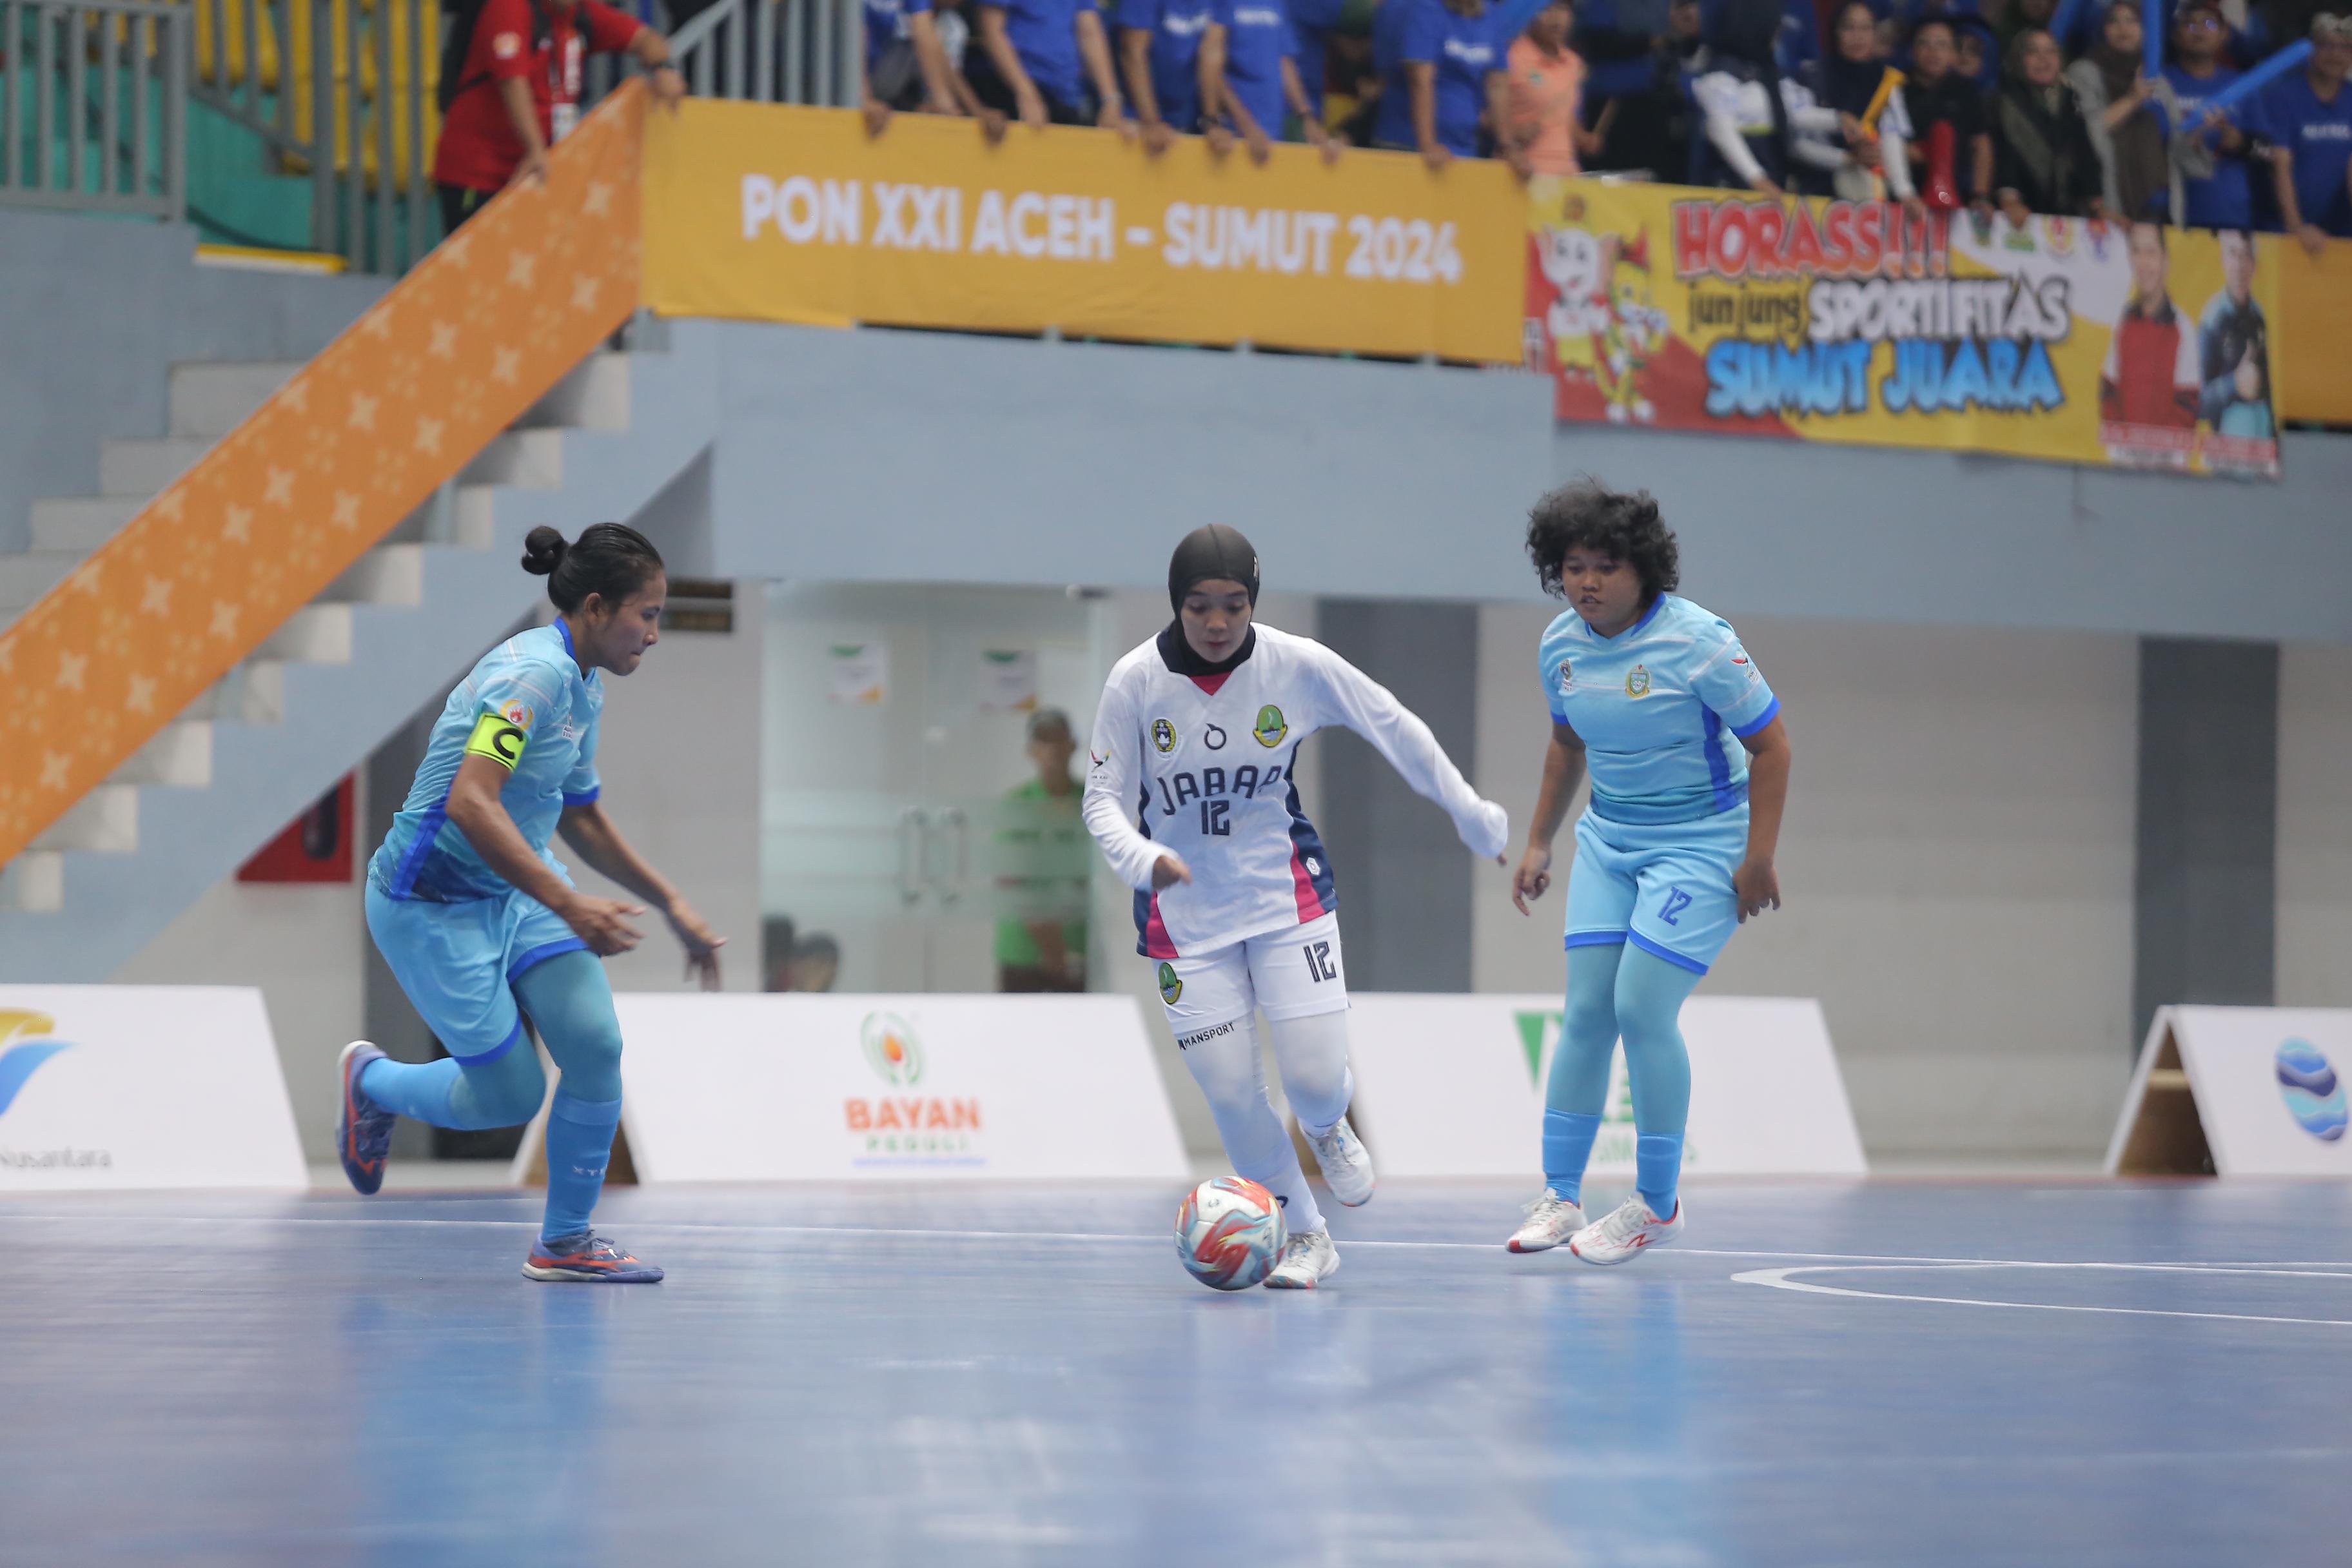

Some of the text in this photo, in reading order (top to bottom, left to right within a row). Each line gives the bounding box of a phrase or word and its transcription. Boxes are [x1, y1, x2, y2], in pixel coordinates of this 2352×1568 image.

[741, 173, 863, 245] PON
[871, 181, 962, 252] XXI
[970, 190, 1115, 261] ACEH
[1162, 201, 1340, 275] SUMUT
[1345, 213, 1463, 284] 2024
[1672, 199, 1951, 280] HORASS!!!
[1704, 337, 2066, 417] SUMUT JUARA
[493, 728, 524, 760] C
[1201, 800, 1230, 836] 12
[1660, 886, 1692, 926] 12
[1304, 941, 1337, 983] 12
[845, 1097, 981, 1130] BAYAN
